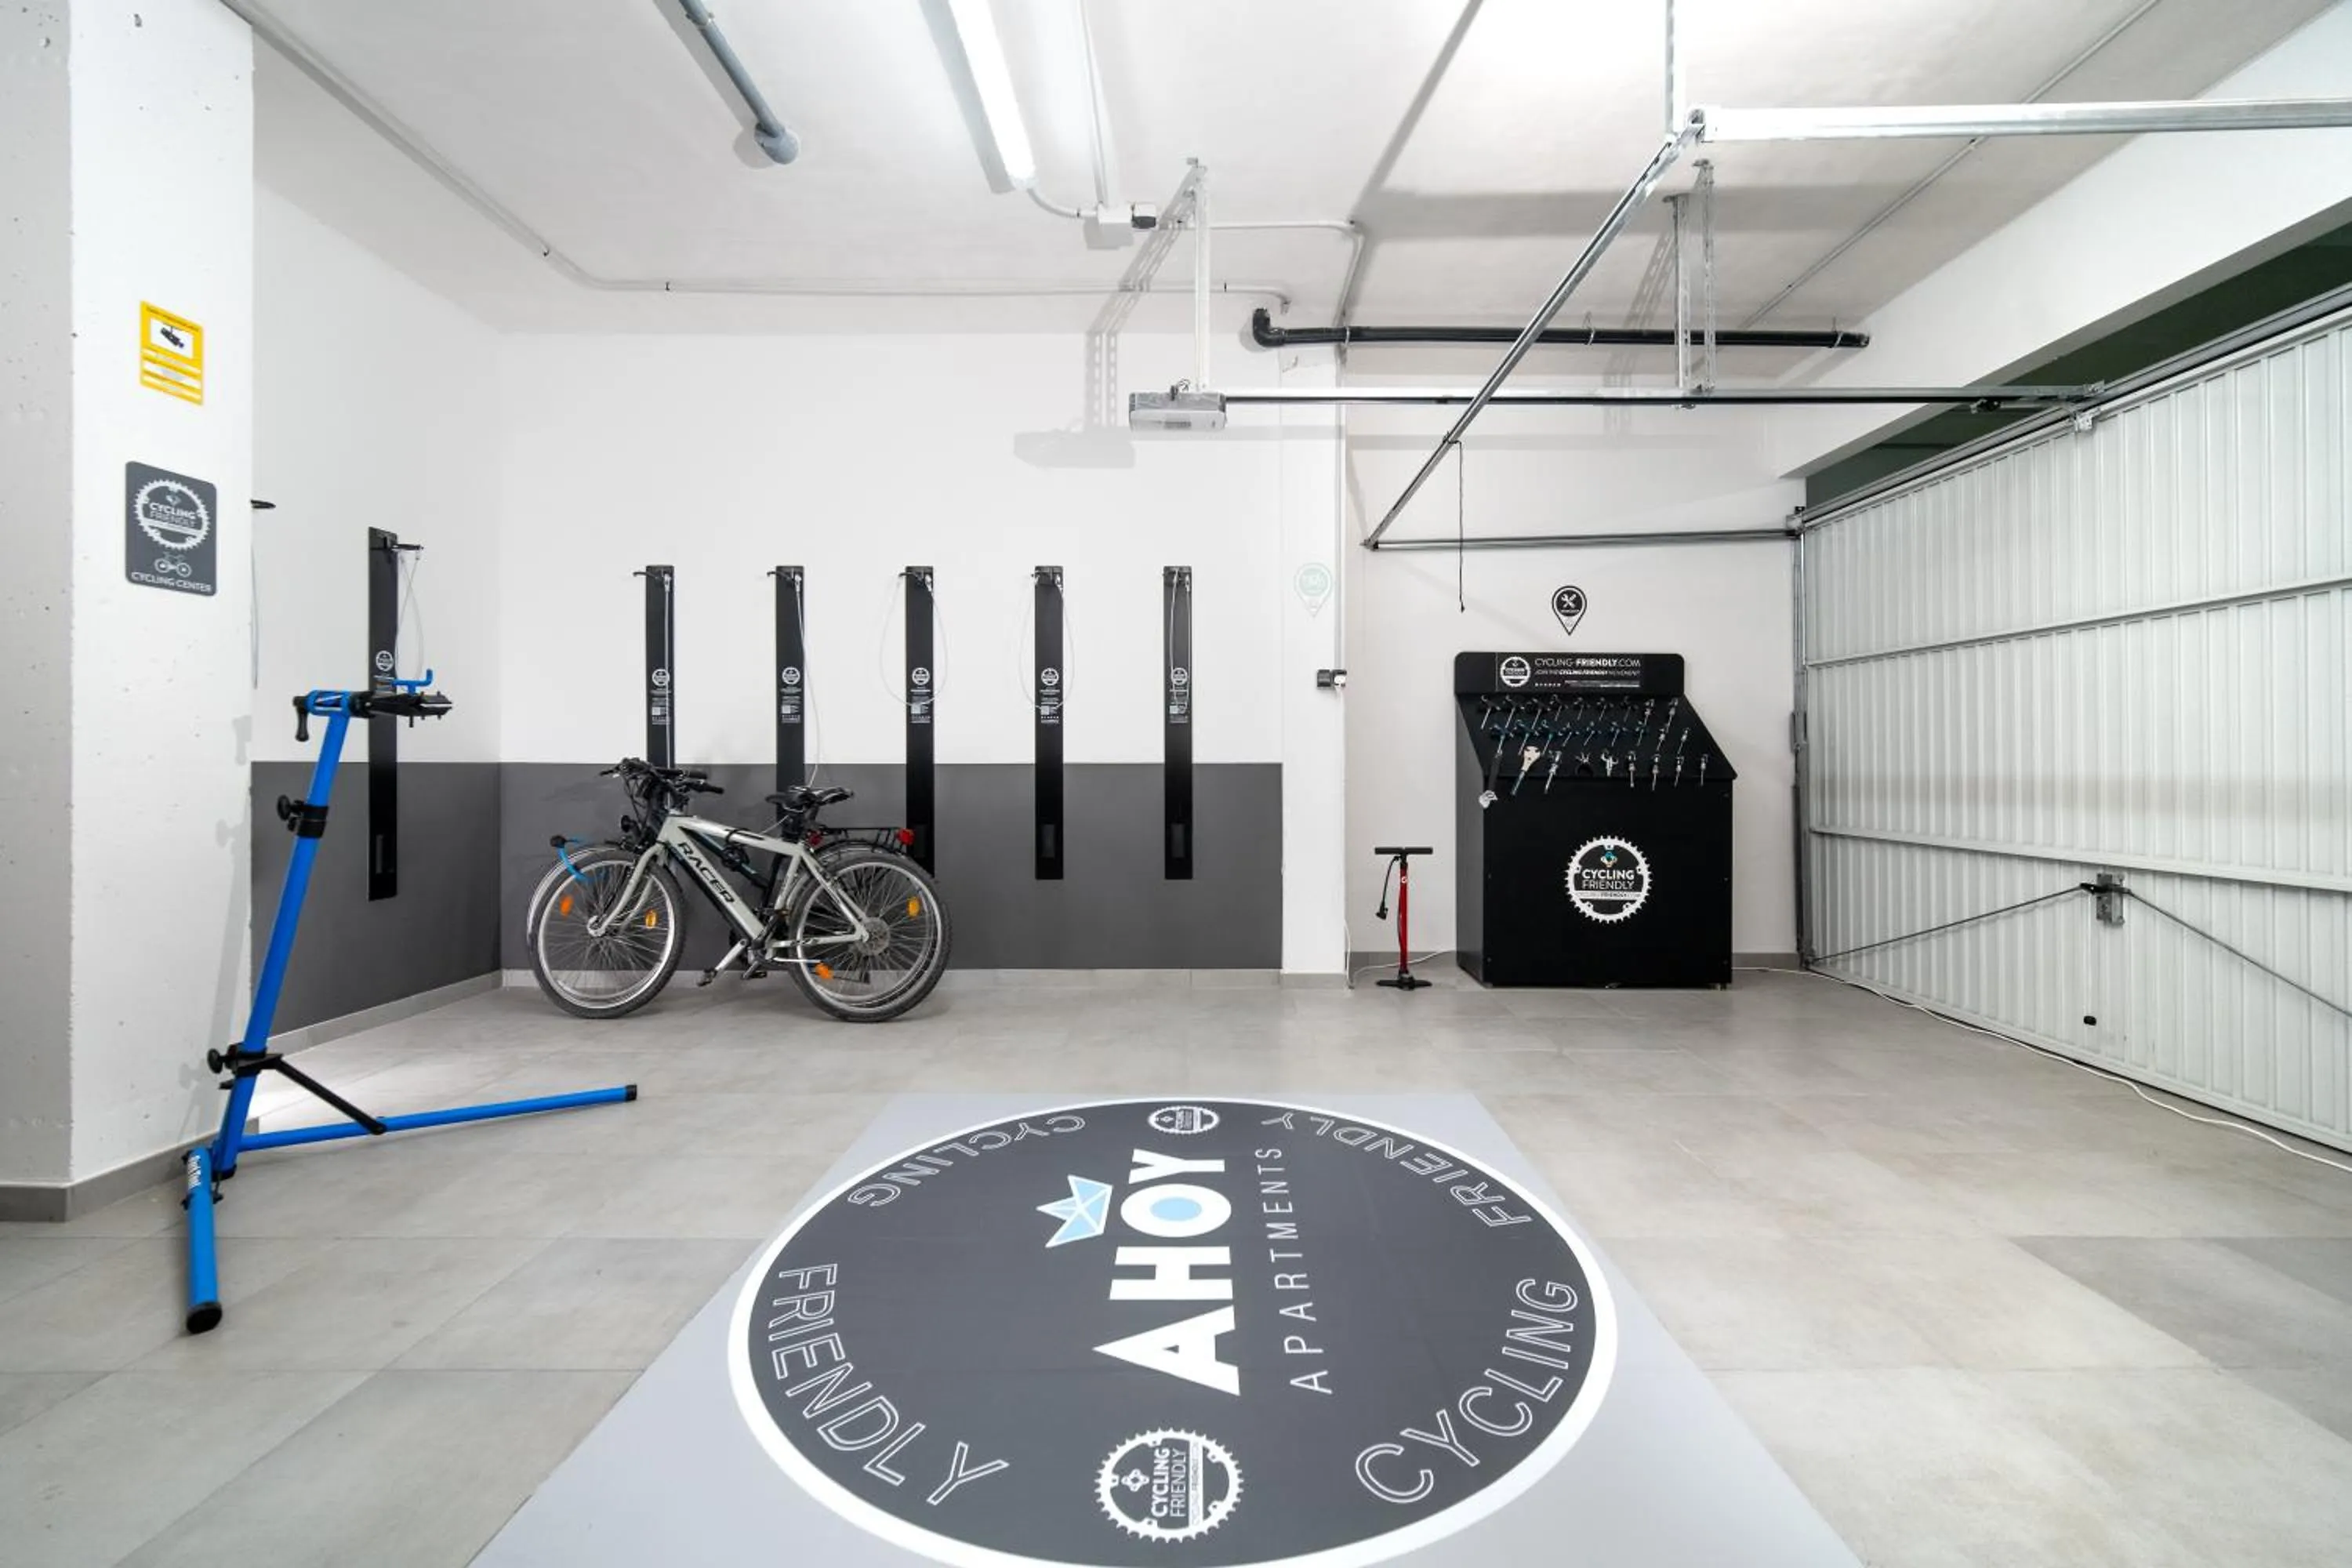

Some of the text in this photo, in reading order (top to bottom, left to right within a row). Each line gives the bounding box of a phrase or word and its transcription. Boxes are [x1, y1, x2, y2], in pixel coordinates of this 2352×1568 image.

[149, 502, 196, 520] CYCLING
[131, 572, 212, 593] CYCLING CENTER
[677, 842, 735, 903] RACER
[1582, 869, 1635, 880] CYCLING
[1582, 879, 1635, 891] FRIENDLY
[848, 1115, 1086, 1207] CYCLING
[1261, 1111, 1532, 1227] FRIENDLY
[1091, 1148, 1241, 1396] AHOY
[1254, 1148, 1334, 1395] APARTMENTS
[768, 1263, 1010, 1505] FRIENDLY
[1355, 1278, 1578, 1504] CYCLING
[1151, 1447, 1170, 1518] CYCLING
[1170, 1447, 1186, 1517] FRIENDLY
